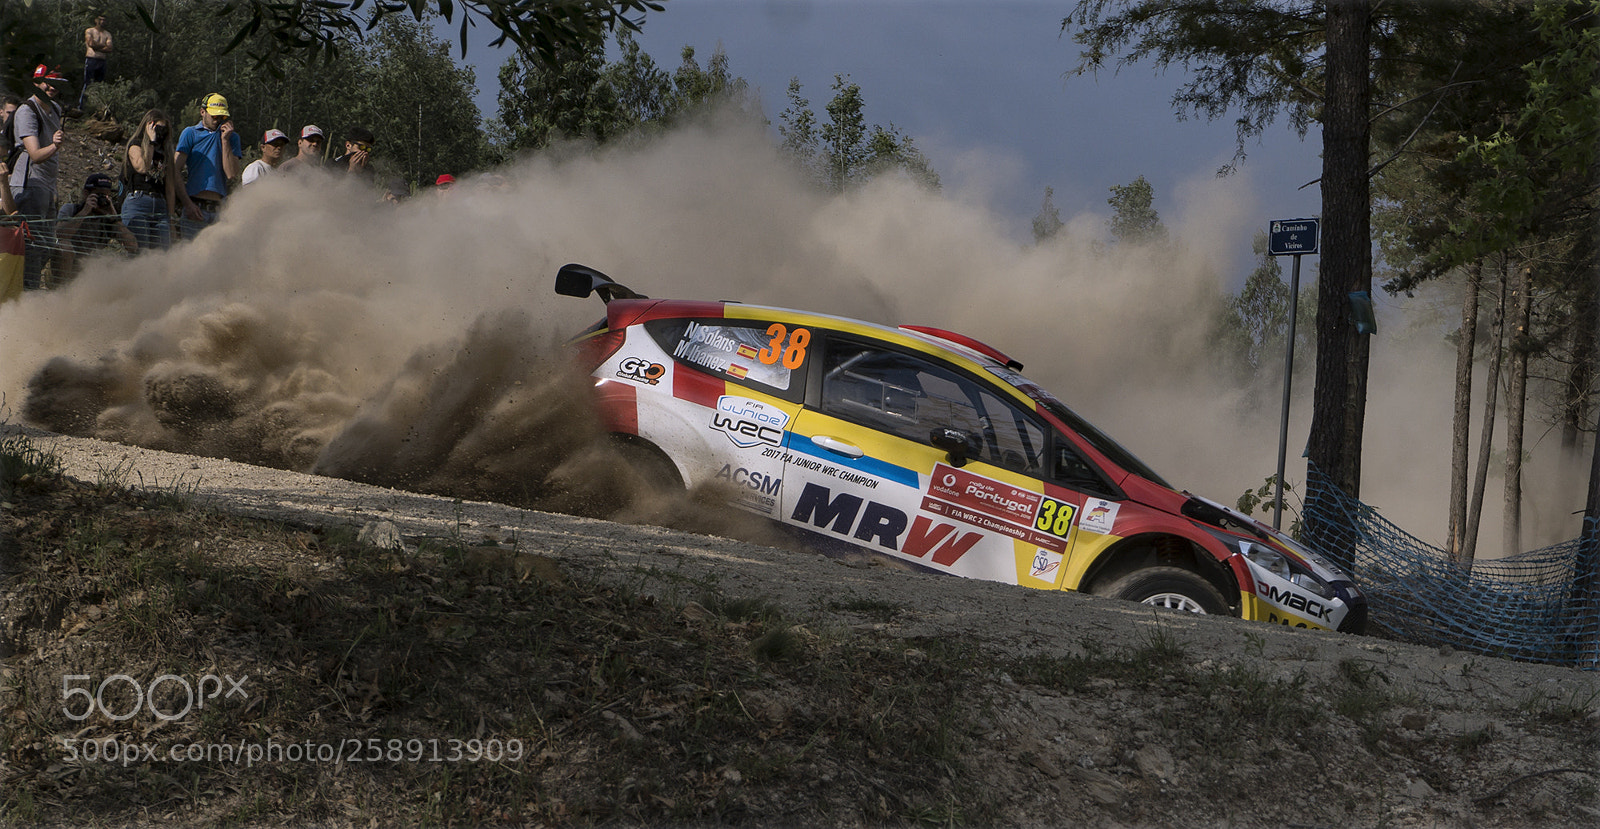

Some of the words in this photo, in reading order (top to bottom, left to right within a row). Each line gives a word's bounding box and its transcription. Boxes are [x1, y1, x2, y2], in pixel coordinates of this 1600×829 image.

[1281, 224, 1308, 232] Caminho
[673, 339, 689, 359] M
[683, 321, 699, 339] N
[697, 325, 735, 353] Solans
[758, 323, 811, 370] 38
[619, 356, 666, 380] GRO
[722, 404, 781, 426] JUNIOR
[745, 401, 764, 410] FIA
[713, 413, 781, 444] WRC
[715, 463, 781, 497] ACSM
[761, 447, 780, 460] 2017
[780, 452, 793, 463] FIA
[793, 456, 822, 472] JUNIOR
[821, 465, 840, 477] WRC
[839, 470, 880, 490] CHAMPION
[933, 485, 960, 497] vodafone
[965, 485, 1033, 514] Portugal
[791, 482, 985, 568] MRW
[951, 509, 962, 518] FIA
[963, 512, 978, 522] WRC
[983, 519, 1026, 538] Championship
[1037, 499, 1073, 536] 38
